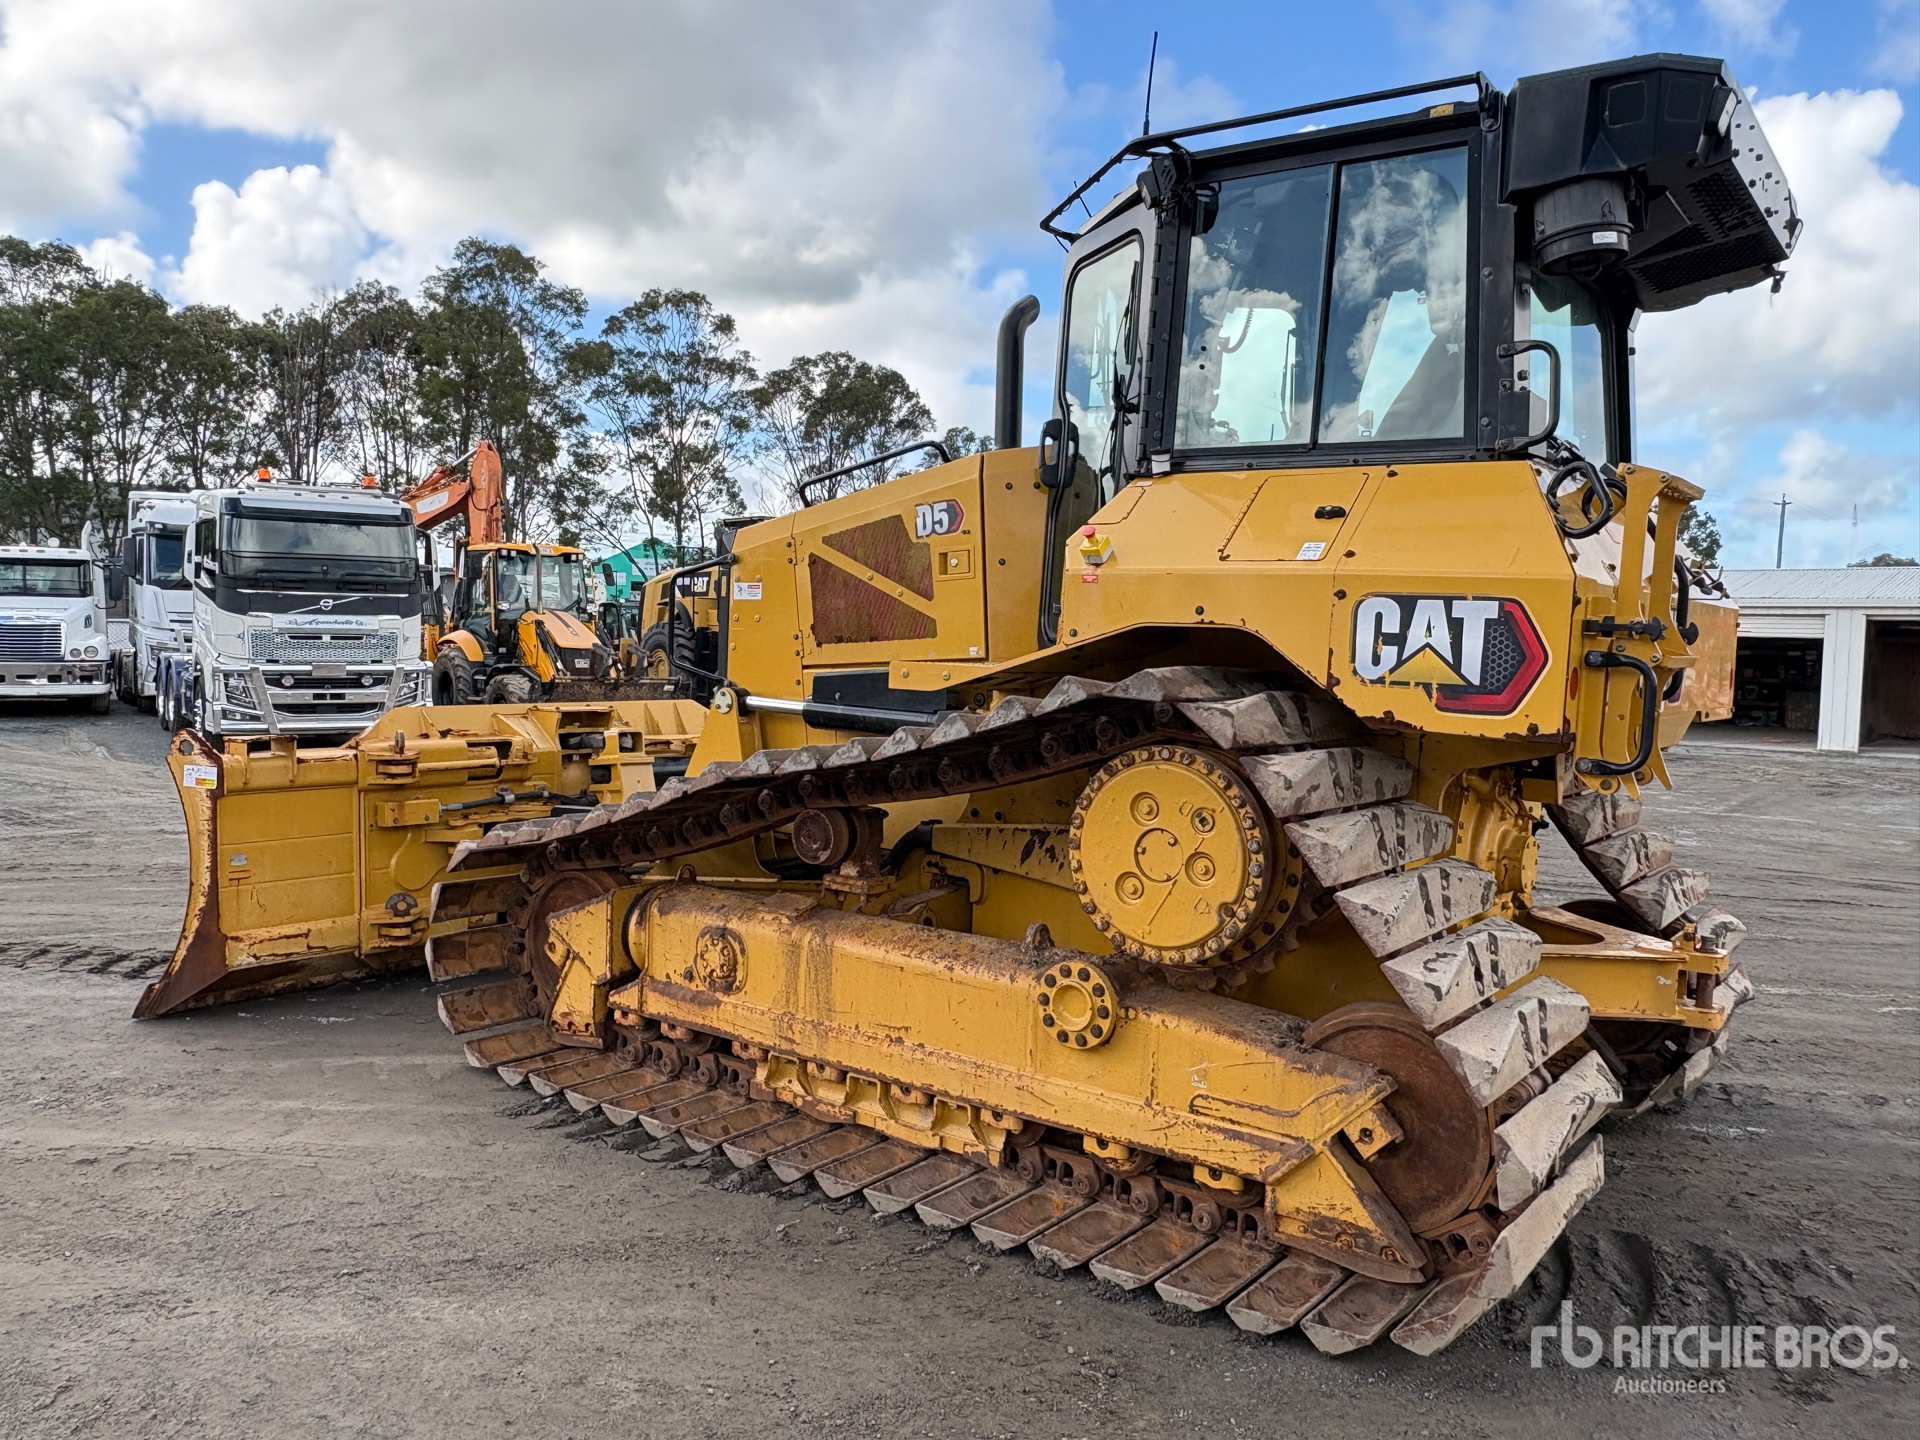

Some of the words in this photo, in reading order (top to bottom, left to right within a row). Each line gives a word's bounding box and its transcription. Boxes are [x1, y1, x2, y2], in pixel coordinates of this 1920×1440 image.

[915, 502, 949, 537] D5
[691, 576, 709, 592] CAT
[1355, 597, 1499, 686] CAT
